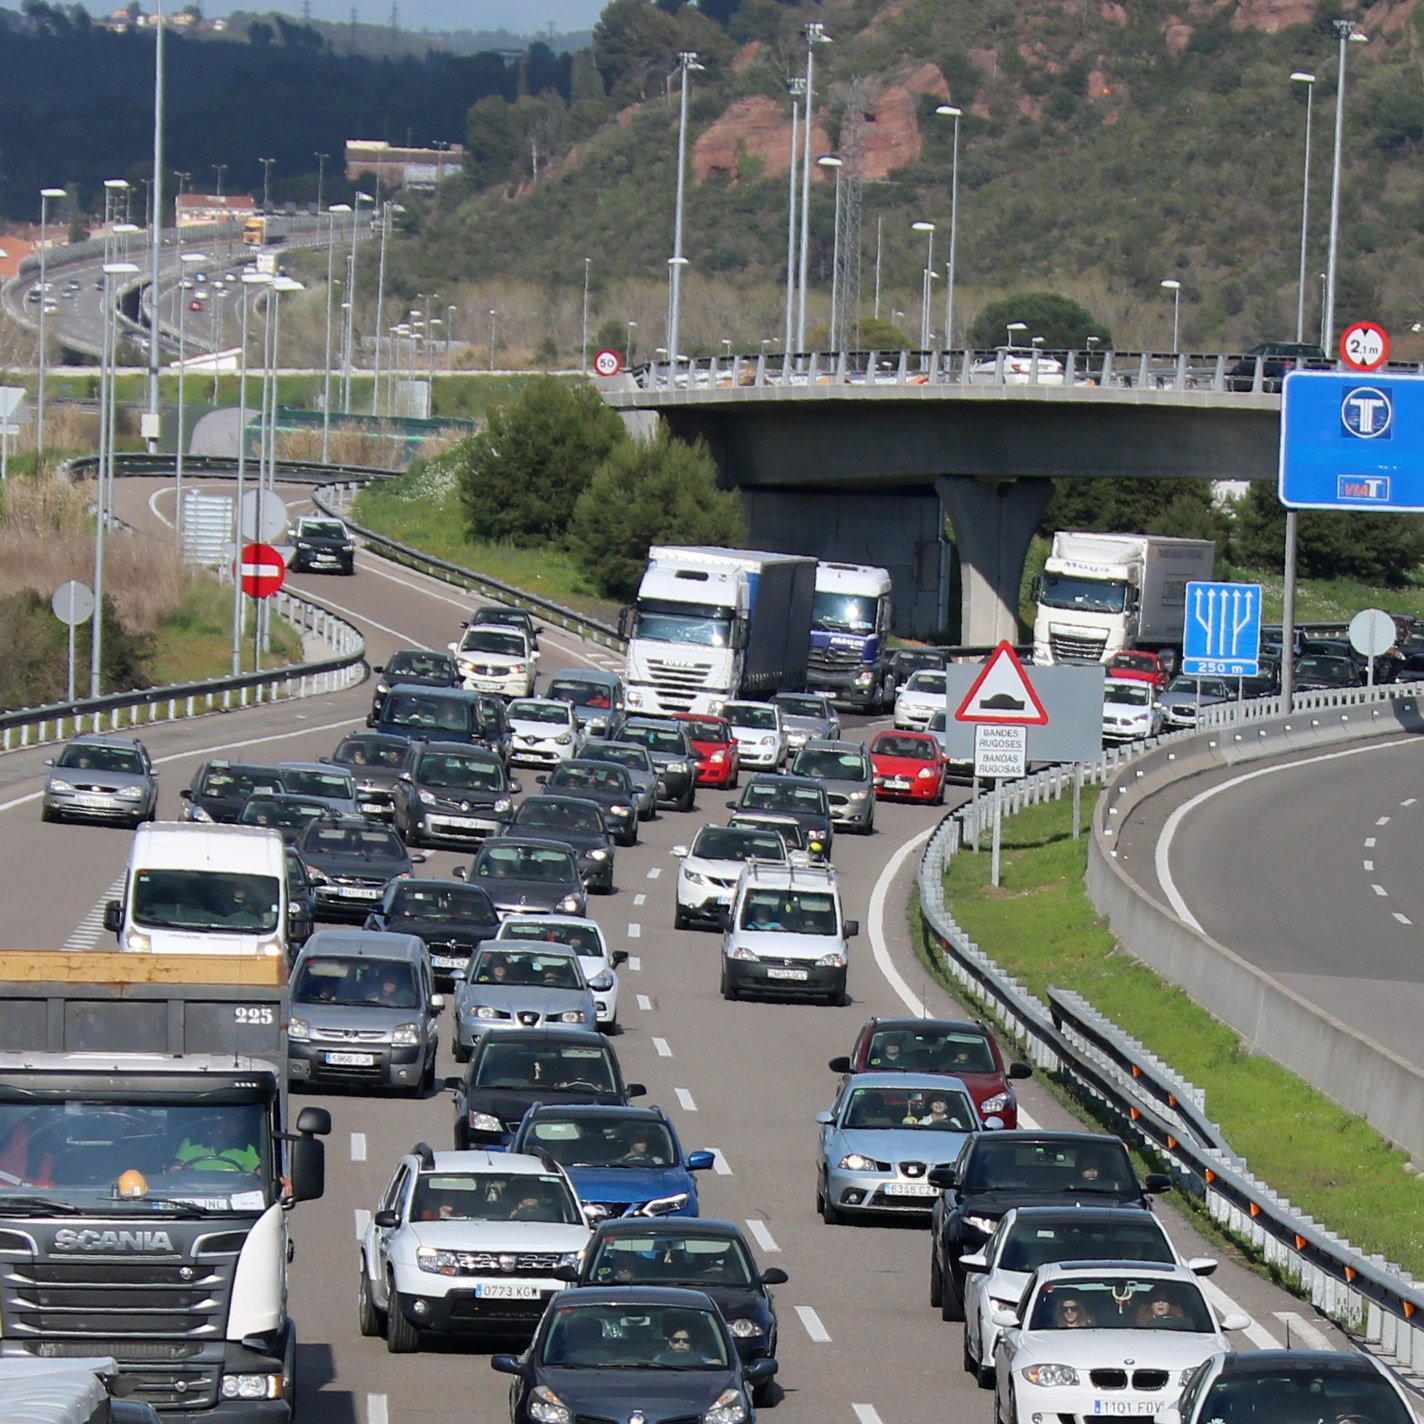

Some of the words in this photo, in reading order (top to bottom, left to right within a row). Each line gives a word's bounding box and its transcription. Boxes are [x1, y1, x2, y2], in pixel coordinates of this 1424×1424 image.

[600, 358, 615, 368] 50
[1198, 661, 1226, 673] 250
[1231, 665, 1243, 675] m
[983, 728, 1019, 738] BANDES
[978, 738, 1023, 749] RUGOSES
[982, 753, 1019, 763] BANDAS
[978, 764, 1022, 774] RUGOSAS
[234, 1006, 273, 1024] 225
[54, 1229, 174, 1250] SCANIA
[483, 1285, 513, 1297] 0773
